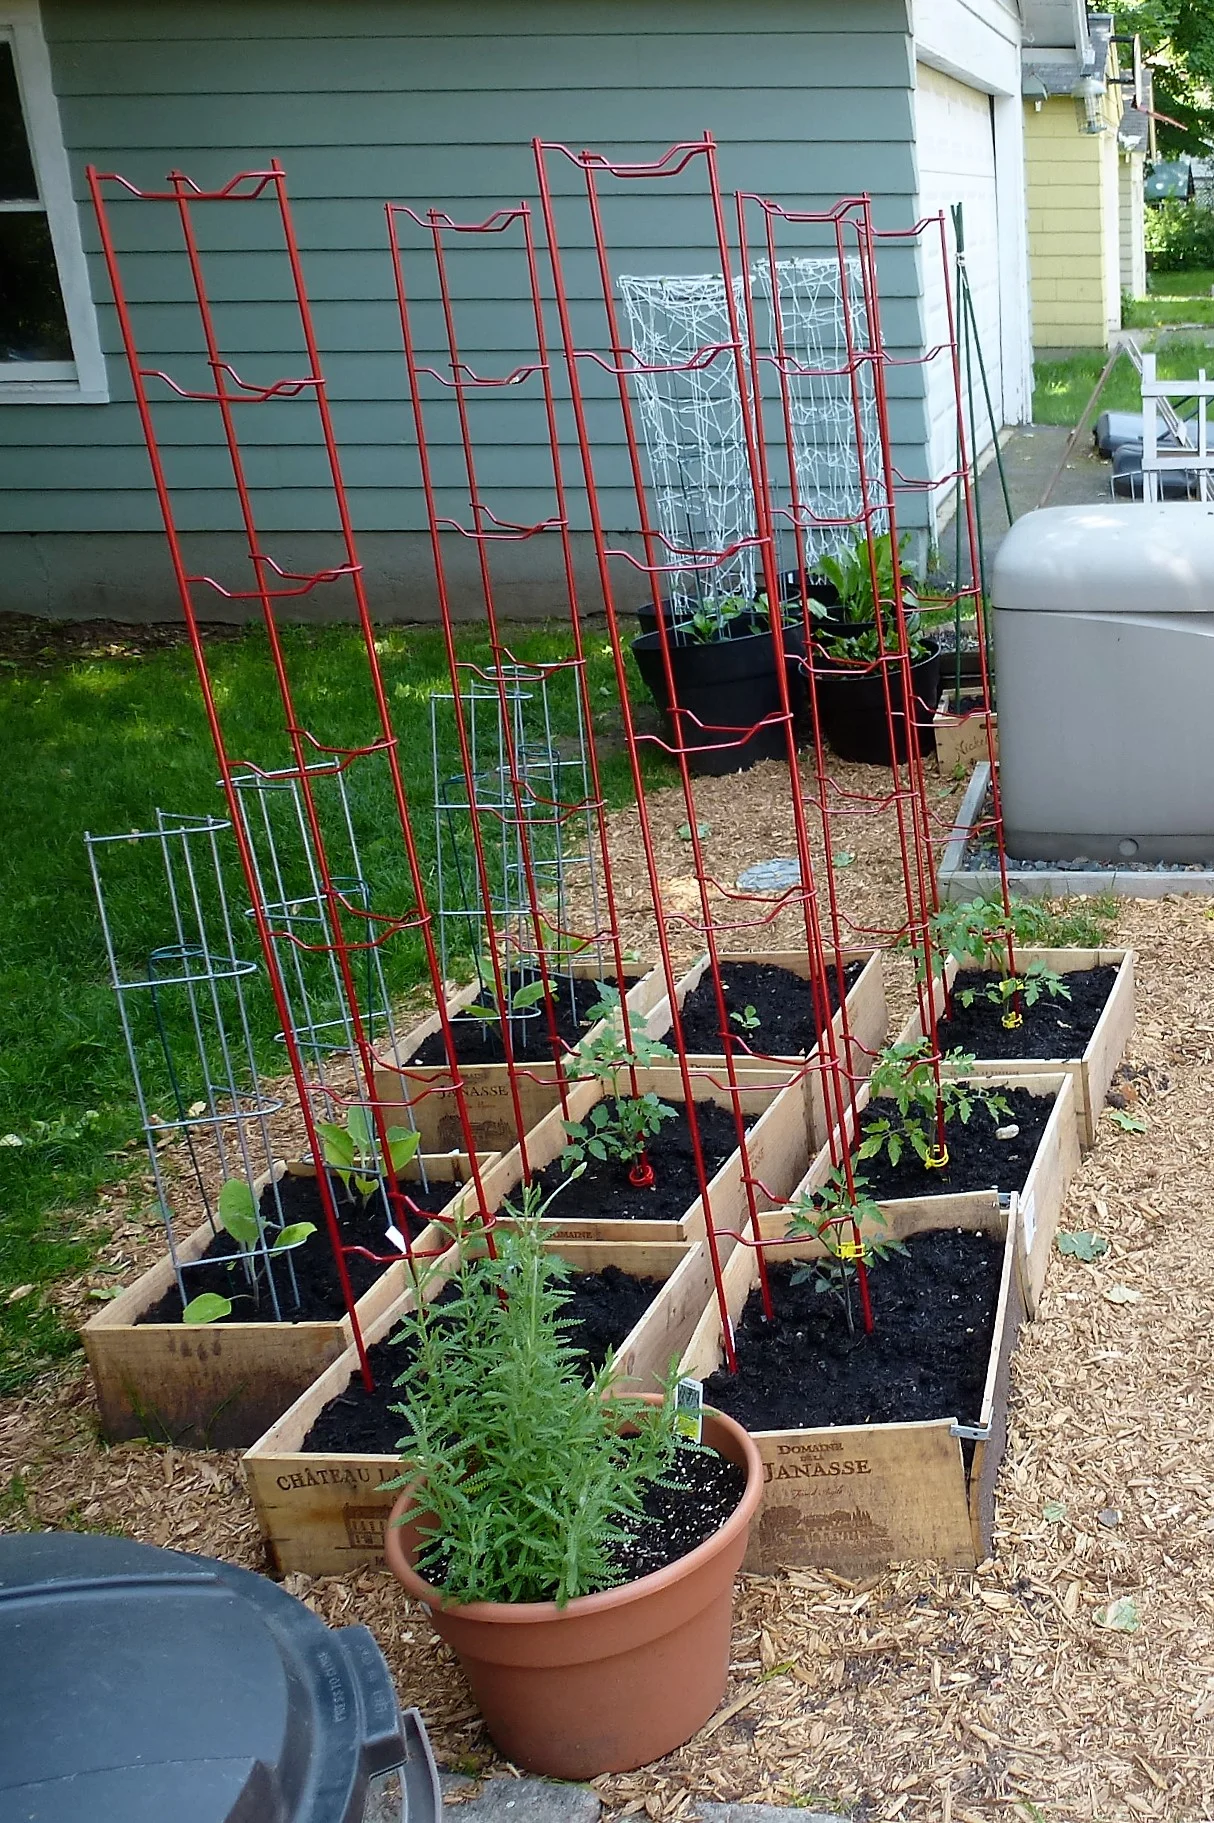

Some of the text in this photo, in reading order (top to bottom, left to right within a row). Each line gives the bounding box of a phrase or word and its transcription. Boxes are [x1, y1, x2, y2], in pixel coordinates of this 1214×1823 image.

[553, 1231, 593, 1239] OMAINE
[777, 1443, 844, 1455] DOMAINE
[276, 1467, 371, 1491] CHÂTEAU
[762, 1460, 872, 1483] JANASSE
